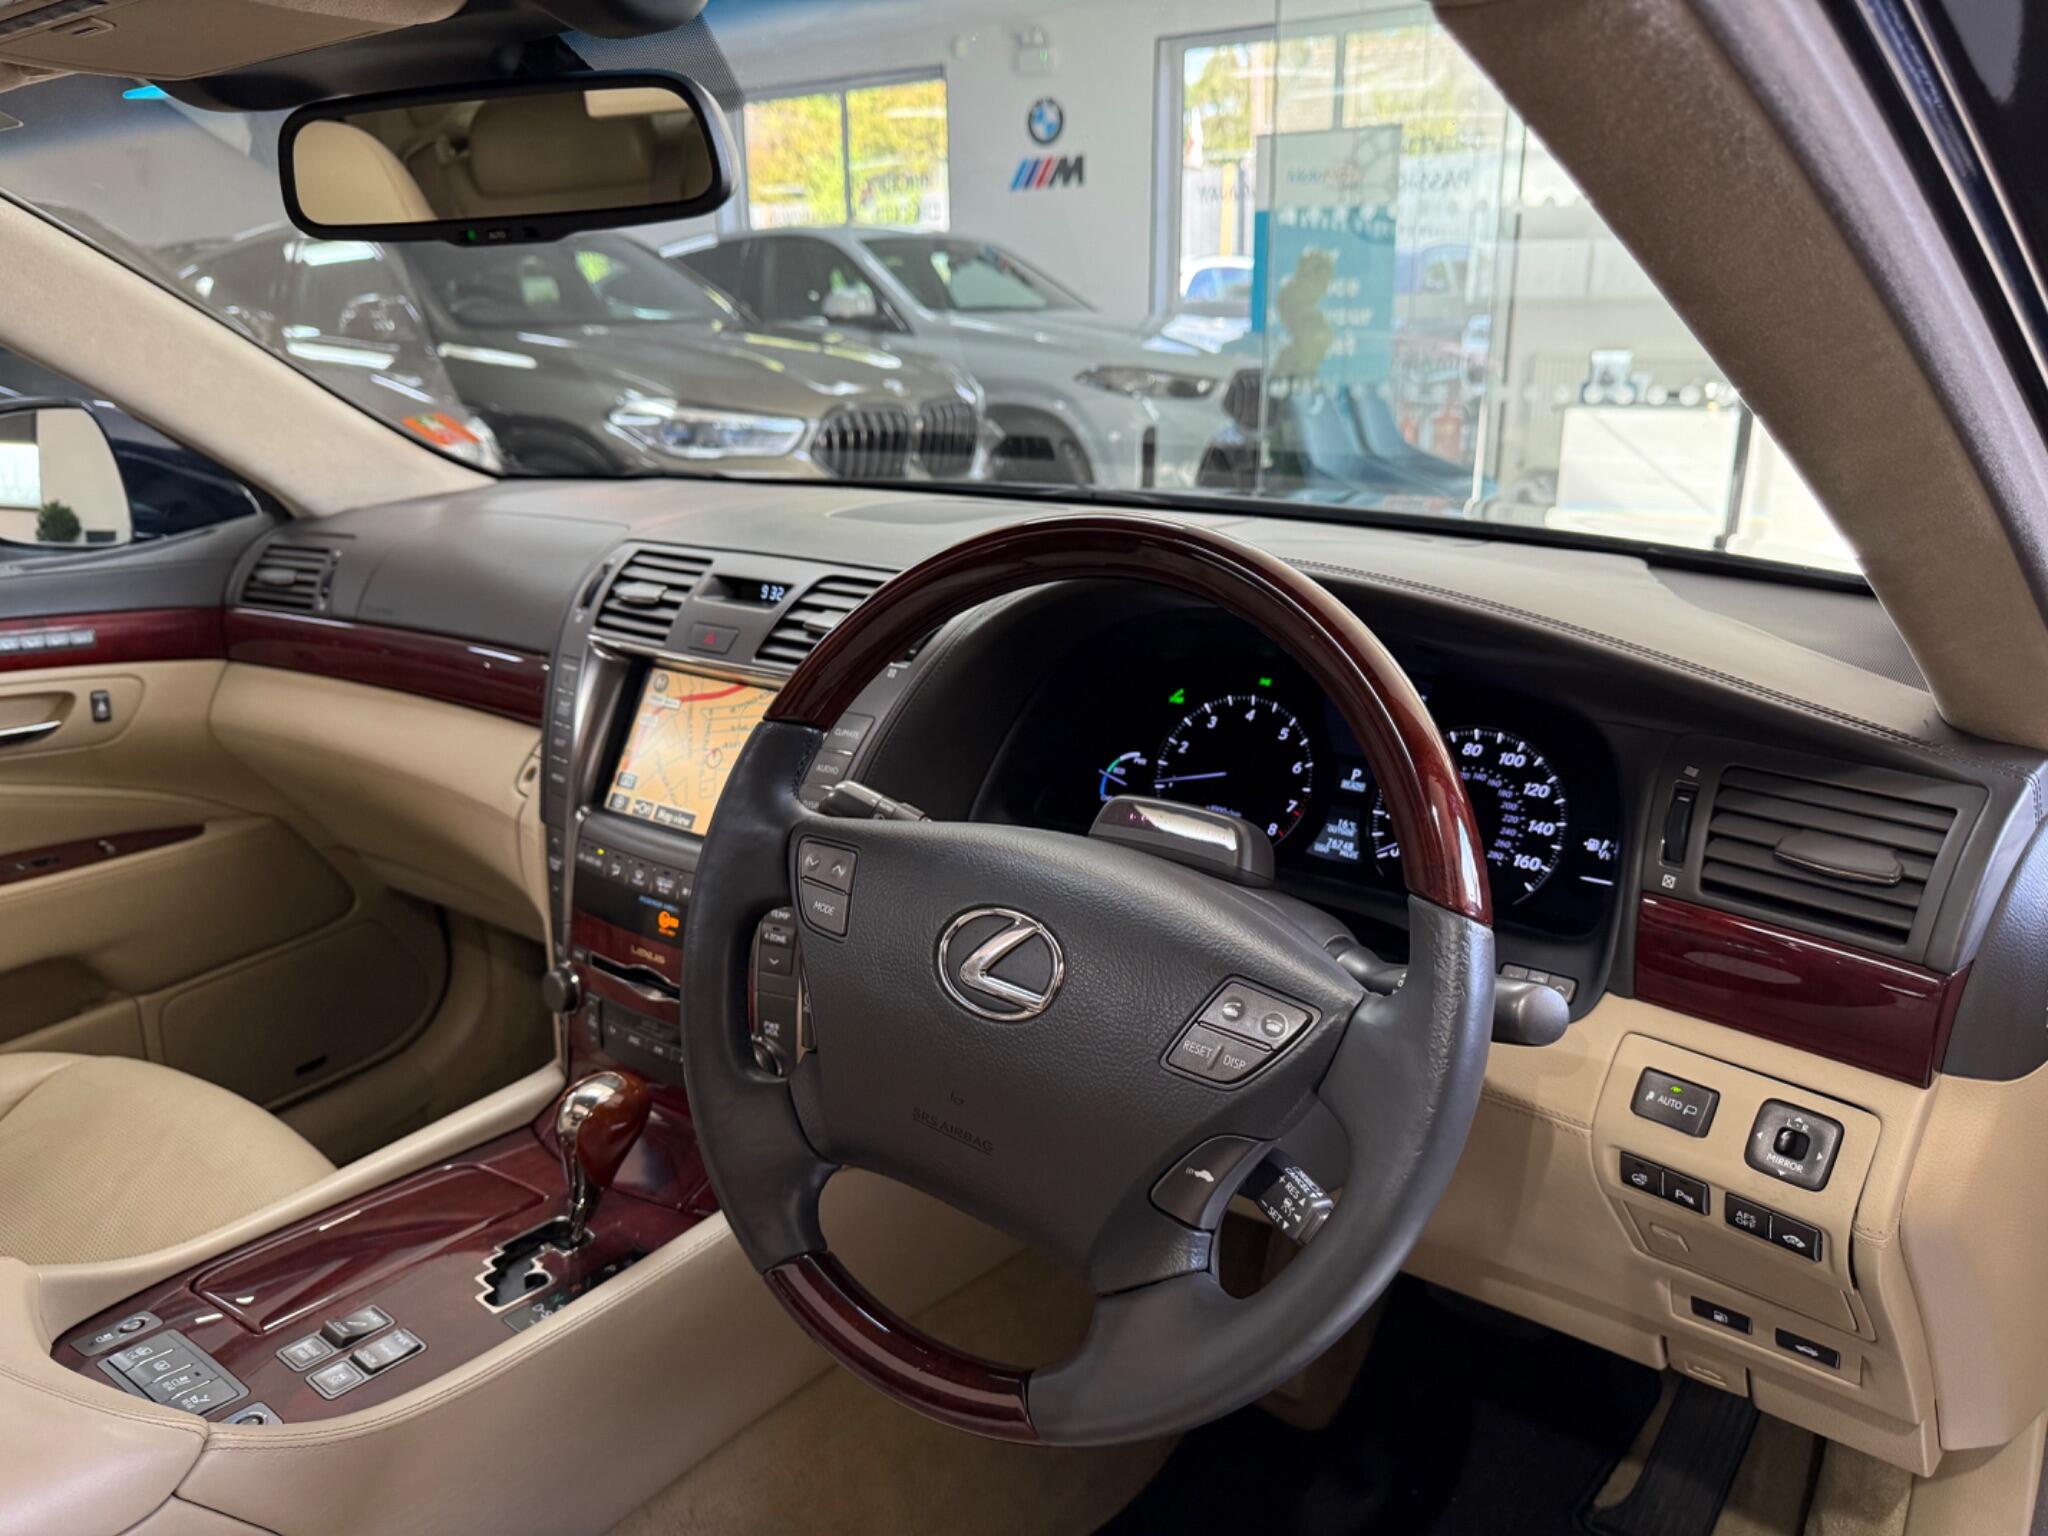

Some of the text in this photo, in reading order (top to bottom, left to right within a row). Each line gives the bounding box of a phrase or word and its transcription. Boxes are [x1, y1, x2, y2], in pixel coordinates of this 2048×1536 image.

[1206, 715, 1218, 729] 3
[1278, 727, 1290, 741] 5
[1178, 740, 1189, 754] 2
[1461, 742, 1484, 757] 80
[1292, 761, 1303, 775] 6
[1499, 752, 1526, 768] 100
[815, 763, 840, 775] AUDIO
[1350, 767, 1363, 781] P
[1523, 782, 1551, 798] 120
[1286, 799, 1299, 813] 7
[1267, 823, 1278, 836] 8
[1528, 819, 1557, 837] 140
[1513, 853, 1543, 871] 160
[813, 900, 835, 916] MODE
[1183, 1039, 1213, 1058] RESET
[1223, 1054, 1247, 1070] DISP
[1657, 1094, 1683, 1110] AUTO
[939, 1121, 993, 1152] AIRBAG
[1766, 1152, 1804, 1174] MIRROR
[1267, 1206, 1283, 1223] SET
